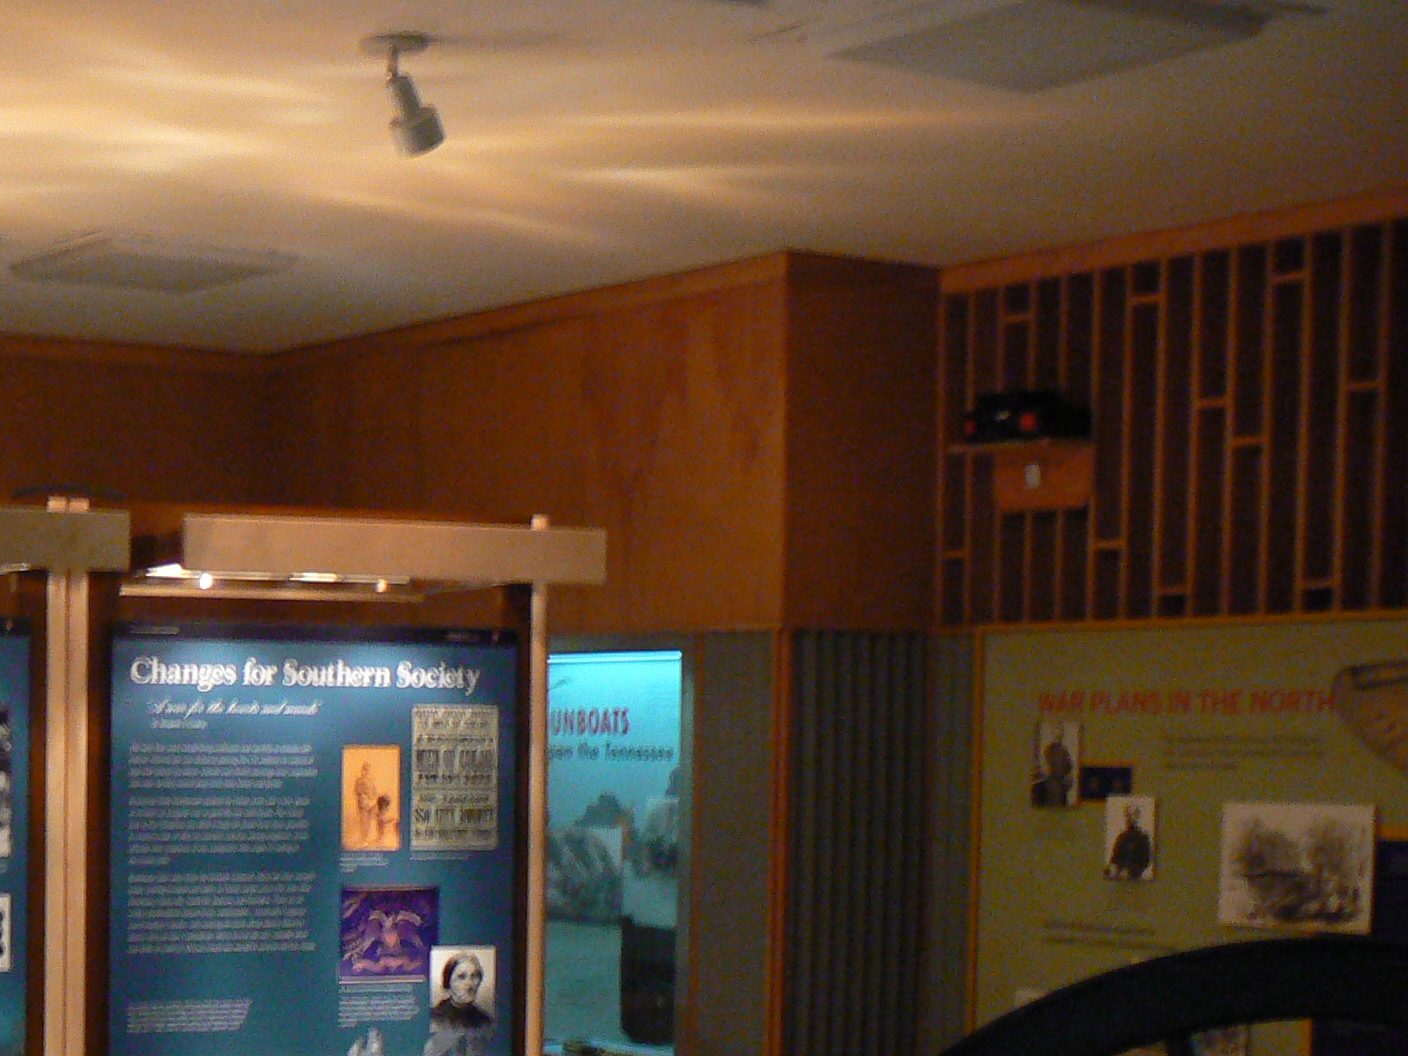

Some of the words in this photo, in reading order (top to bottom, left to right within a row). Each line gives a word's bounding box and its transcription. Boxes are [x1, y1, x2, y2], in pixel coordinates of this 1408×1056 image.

[129, 656, 238, 692] Changes
[242, 657, 278, 686] for
[282, 658, 392, 688] Southern
[396, 660, 482, 696] Society
[1038, 691, 1083, 713] WAR
[1090, 691, 1162, 714] PLANS
[1168, 691, 1192, 714] IN
[1200, 690, 1243, 714] THE
[1251, 690, 1335, 713] NORTH
